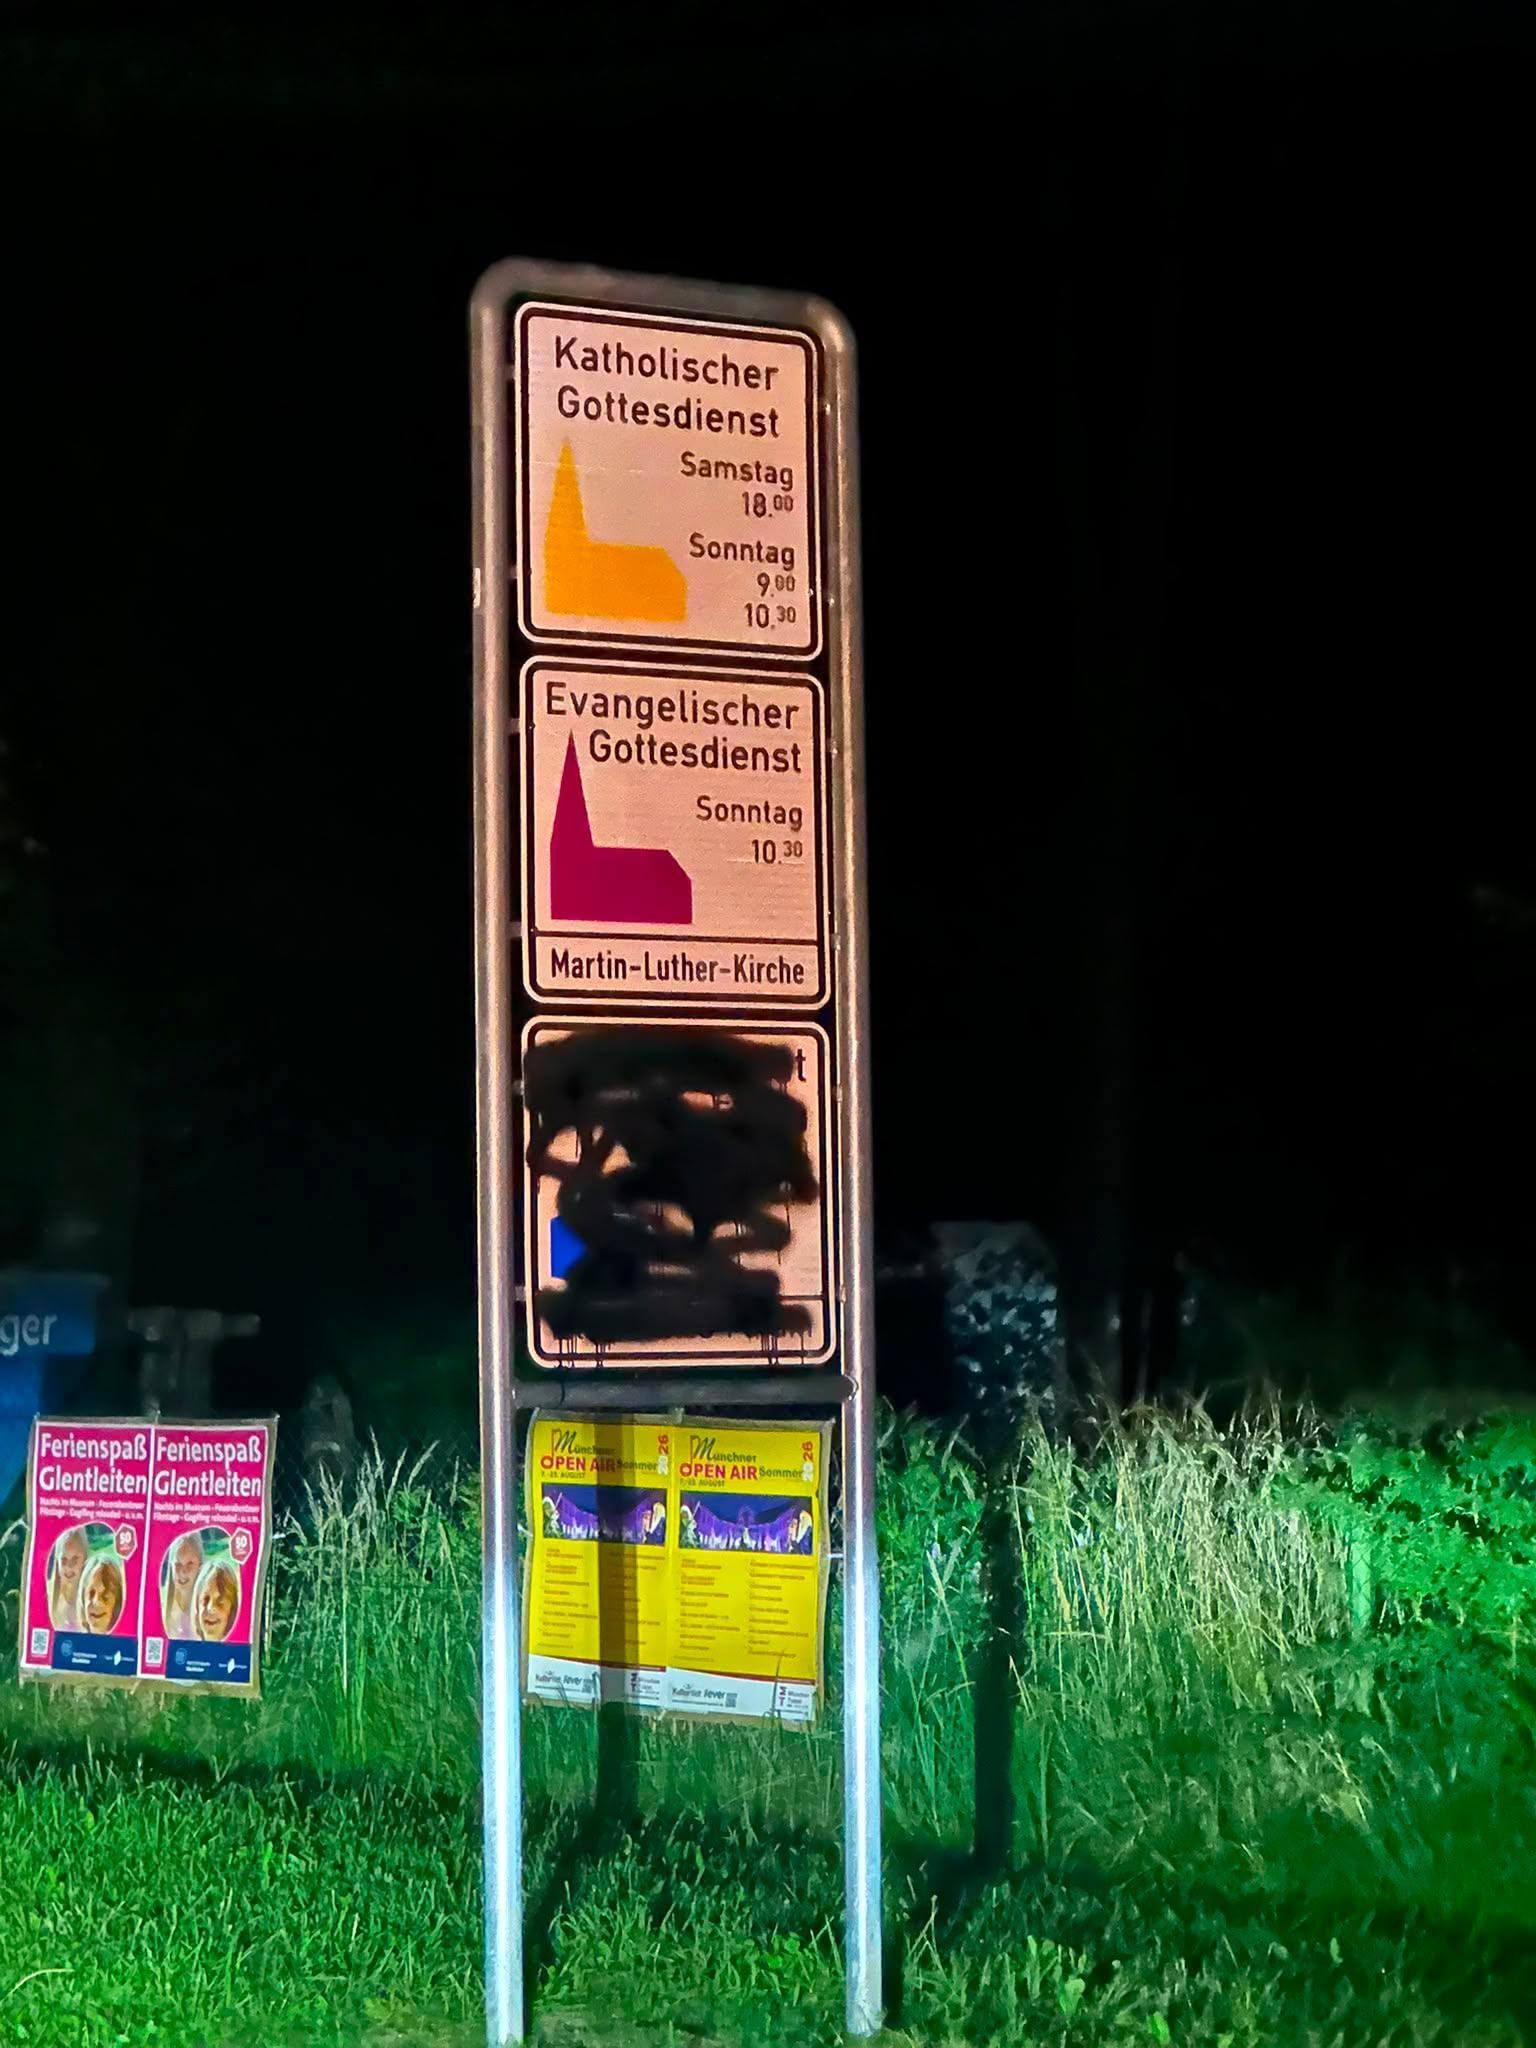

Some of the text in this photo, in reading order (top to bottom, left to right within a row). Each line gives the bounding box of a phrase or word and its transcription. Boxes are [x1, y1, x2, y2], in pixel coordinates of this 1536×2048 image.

[555, 335, 779, 390] Katholischer
[557, 385, 780, 438] Gottesdienst
[680, 451, 794, 491] Samstag
[689, 532, 795, 571] Sonntag
[546, 681, 799, 730] Evangelischer
[589, 729, 802, 773] Gottesdienst
[696, 795, 802, 832] Sonntag
[550, 948, 805, 985] Martin-Luther-Kirche
[41, 1433, 147, 1467] Ferienspaß
[156, 1436, 262, 1471] Ferienspaß
[540, 1455, 586, 1471] OPEN
[590, 1457, 616, 1473] AIR
[39, 1465, 147, 1494] Glentleiten
[154, 1469, 262, 1497] Glentleiten
[679, 1462, 726, 1478] OPEN
[730, 1464, 758, 1480] AIR
